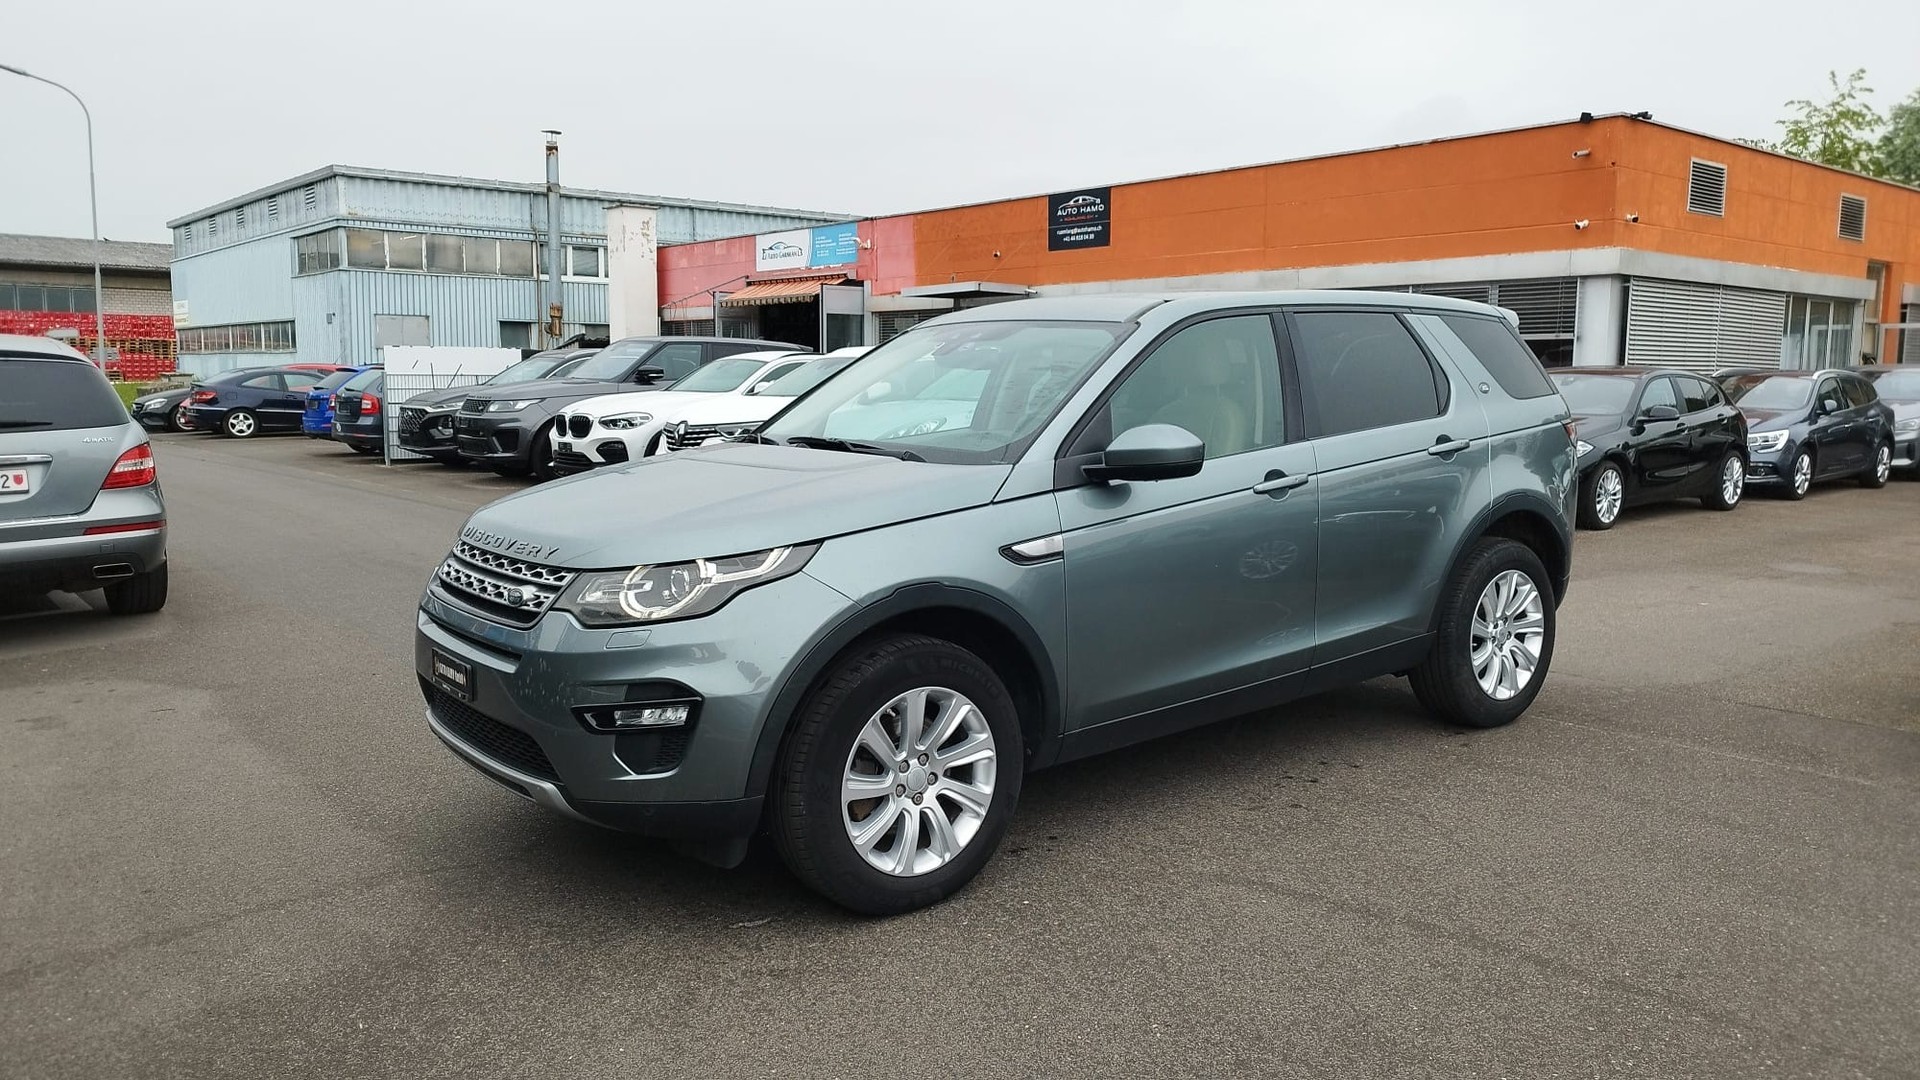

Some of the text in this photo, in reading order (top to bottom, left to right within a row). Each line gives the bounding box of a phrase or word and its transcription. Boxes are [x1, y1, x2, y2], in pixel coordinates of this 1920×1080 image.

[1057, 204, 1105, 216] AUTO HAMO
[463, 526, 560, 560] DISCOVERY
